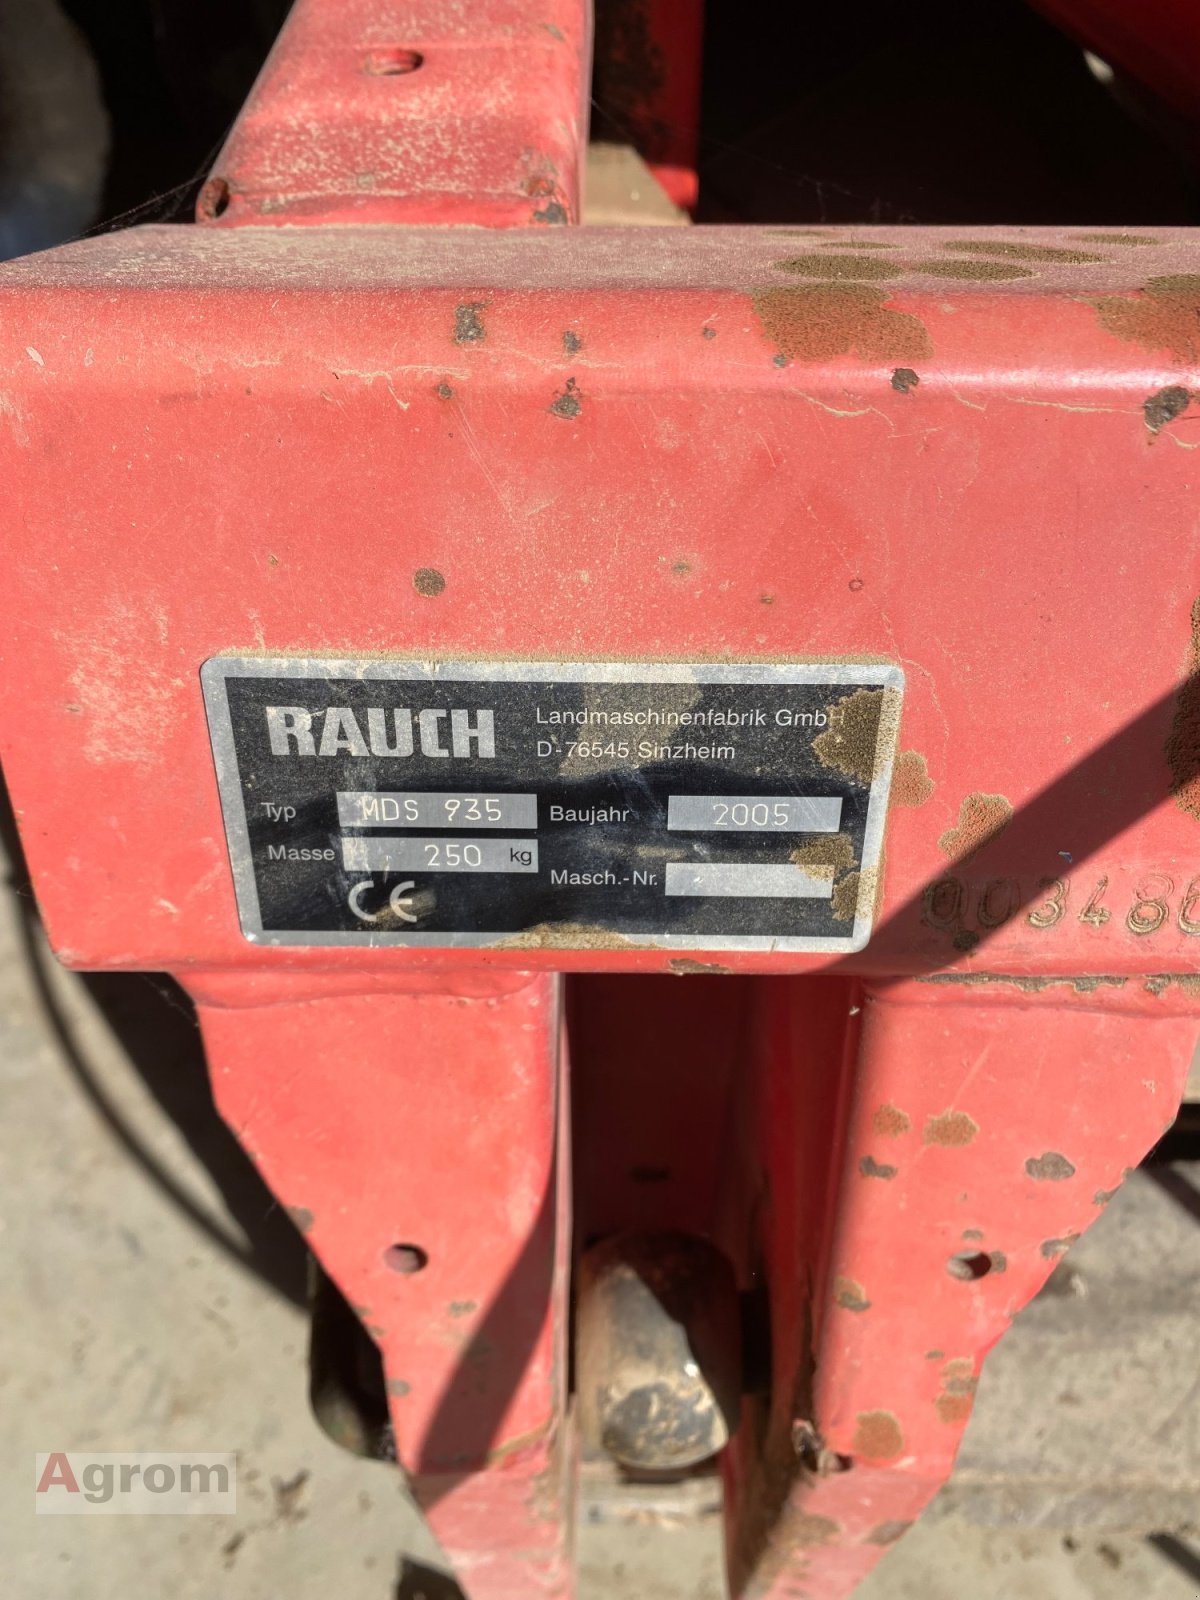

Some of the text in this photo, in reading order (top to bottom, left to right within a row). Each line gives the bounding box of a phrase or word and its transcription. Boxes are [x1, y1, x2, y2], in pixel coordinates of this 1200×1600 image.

[536, 708, 766, 727] Landmaschinenfabrik
[266, 706, 496, 759] RAUCH
[536, 741, 736, 760] D-76545 Sinzheim
[261, 798, 502, 822] Typ MDS 935
[550, 803, 790, 826] Baujahr 2005
[268, 844, 532, 867] Masse 250 kg
[550, 869, 658, 887] Masch.-Nr.
